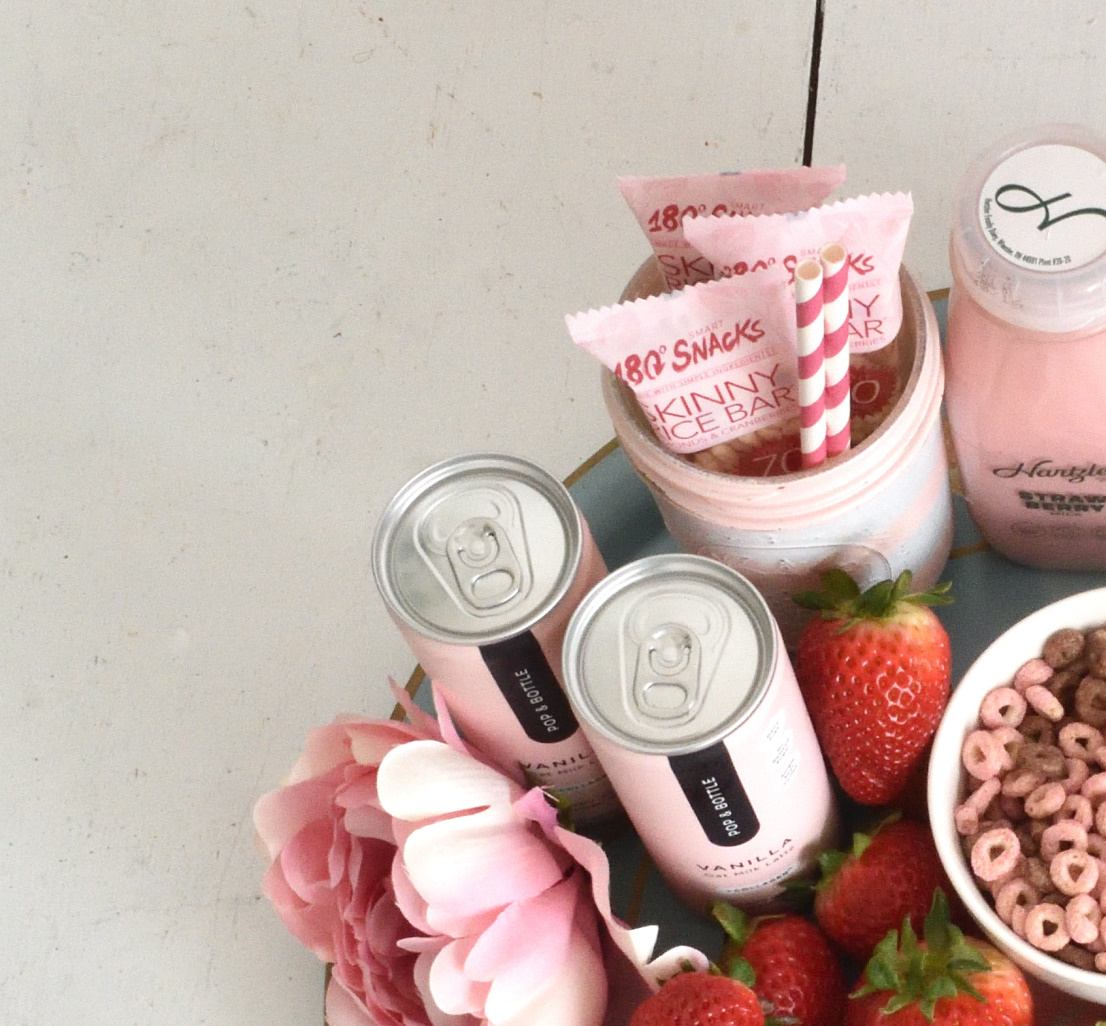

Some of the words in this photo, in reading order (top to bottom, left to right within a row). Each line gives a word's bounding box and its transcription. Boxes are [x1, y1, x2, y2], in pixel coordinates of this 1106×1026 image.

[672, 318, 766, 373] SNACKS
[724, 386, 795, 424] BAR
[514, 668, 544, 705] BOTTLE
[540, 713, 559, 732] POP
[701, 776, 728, 810] BOTTLE
[719, 810, 732, 818] &
[722, 818, 741, 837] POP
[696, 838, 792, 871] VANILLA
